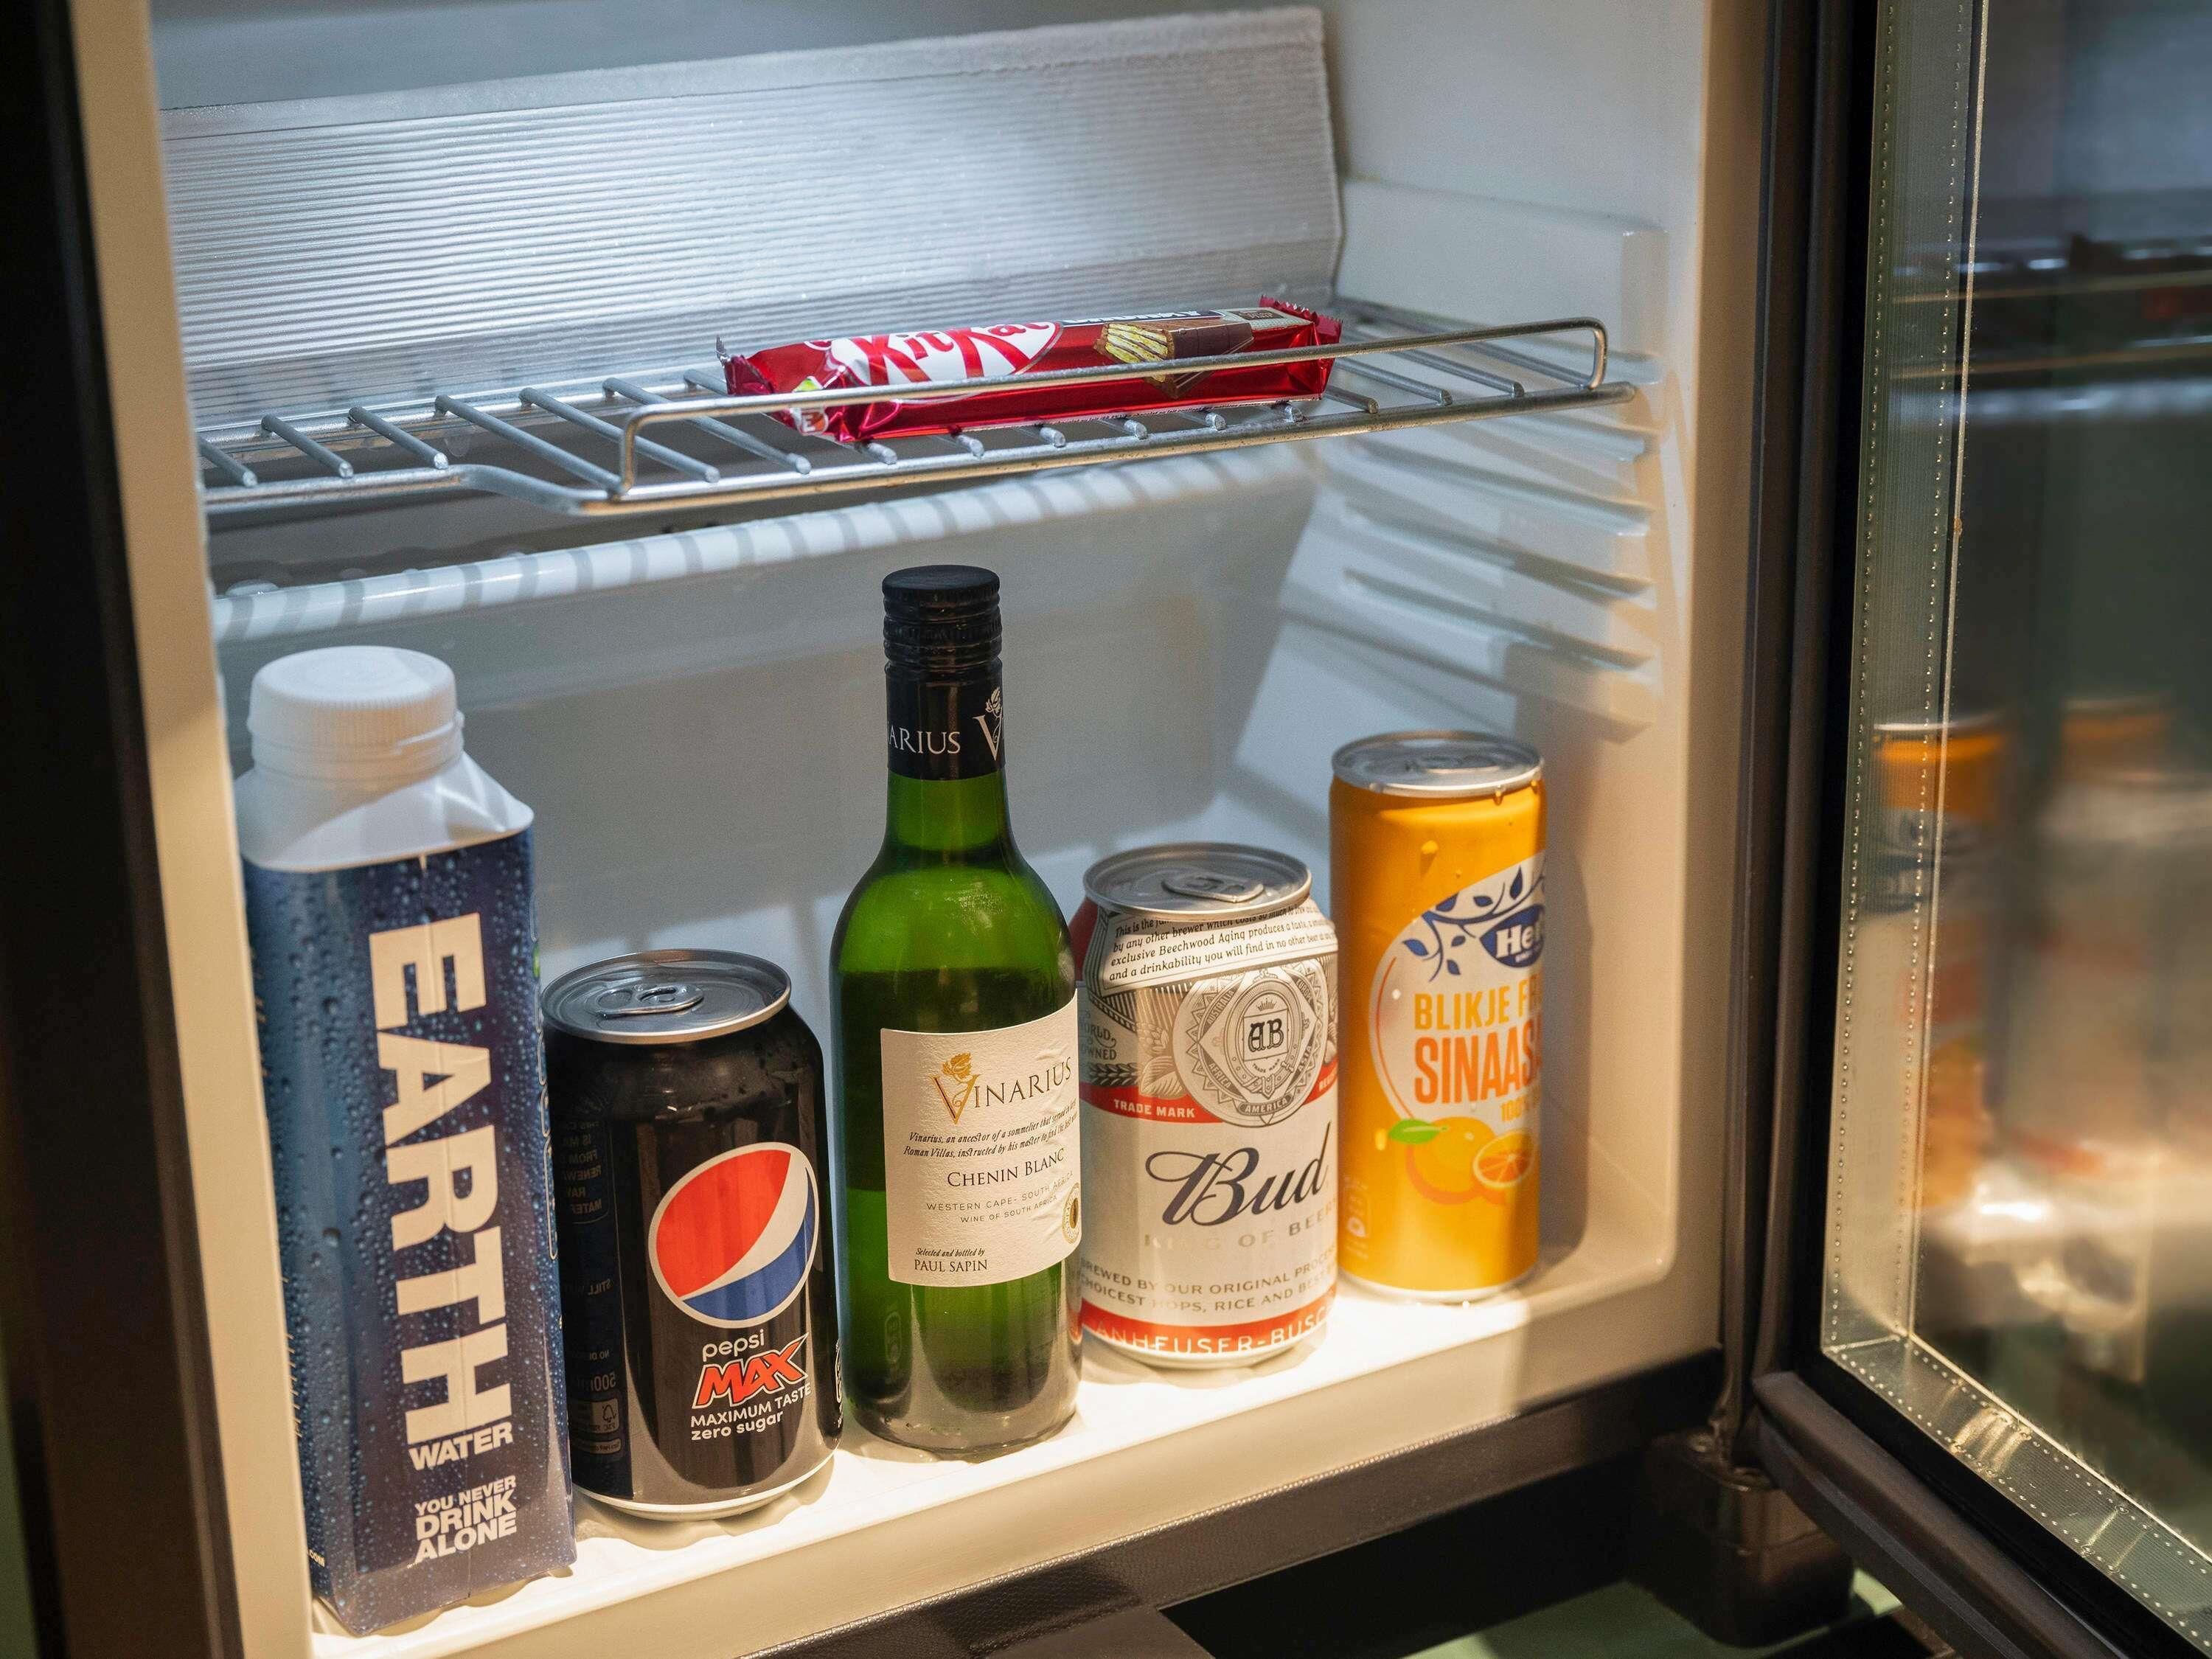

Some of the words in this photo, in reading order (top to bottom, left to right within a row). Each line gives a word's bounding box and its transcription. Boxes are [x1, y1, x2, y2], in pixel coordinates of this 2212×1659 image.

[1110, 949, 1155, 967] exclusive
[1159, 934, 1215, 956] Beechwood
[1218, 930, 1245, 944] Aging
[1248, 923, 1284, 939] produces
[1113, 941, 1124, 953] by
[1126, 937, 1144, 950] any
[1145, 931, 1169, 945] other
[1172, 923, 1204, 938] brewer
[1115, 923, 1132, 939] This
[1133, 922, 1140, 932] is
[1141, 917, 1154, 931] the
[1109, 967, 1128, 981] and
[1130, 968, 1137, 976] a
[1140, 955, 1202, 975] drinkability
[1204, 951, 1223, 964] you
[1225, 947, 1243, 958] will
[1245, 942, 1264, 956] find
[1266, 941, 1275, 950] in
[1276, 940, 1287, 949] no
[1287, 935, 1305, 947] other
[1206, 987, 1237, 1025] AUSTRALIA
[1414, 985, 1510, 1031] BLIKJE
[1248, 1018, 1285, 1053] AB
[1208, 1061, 1232, 1088] AFRICA
[1298, 1044, 1312, 1071] ASIA
[1113, 1099, 1152, 1116] TRADE
[1156, 1106, 1196, 1119] MARK
[1244, 1099, 1290, 1114] AMERICA
[903, 1145, 929, 1156] Roman
[931, 1147, 956, 1158] Villas,
[958, 1144, 997, 1158] instructed
[998, 1144, 1006, 1155] by
[1007, 1141, 1018, 1152] his
[1020, 1135, 1040, 1149] master
[1040, 1132, 1047, 1142] to
[908, 1131, 944, 1144] Vinarius,
[945, 1135, 956, 1143] an
[958, 1133, 991, 1143] ancestor
[992, 1129, 1001, 1142] of
[1007, 1121, 1040, 1137] sommelier
[1040, 1116, 1051, 1128] that
[369, 912, 512, 1445] EARTH
[947, 1165, 1019, 1187] CHENIN
[1025, 1147, 1065, 1177] BLANC
[1144, 1120, 1333, 1227] Bud
[926, 1202, 981, 1211] WESTERN
[1021, 1186, 1050, 1202] SOUTH
[1053, 1170, 1074, 1190] AFRICA
[960, 1215, 984, 1223] WINE
[989, 1212, 1000, 1221] OF
[1004, 1206, 1032, 1217] SOUTH
[1034, 1196, 1057, 1210] AFRICA
[915, 1247, 942, 1257] Selected
[941, 1248, 954, 1257] and
[954, 1248, 978, 1257] bottled
[978, 1248, 986, 1257] by
[1238, 1229, 1274, 1248] OF
[914, 1259, 945, 1272] PAUL
[949, 1259, 988, 1273] SAPIN
[1138, 1279, 1156, 1290] BY
[1164, 1282, 1203, 1295] OUR
[1209, 1272, 1291, 1295] ORIGINAL
[1214, 1297, 1256, 1311] RICE
[1261, 1288, 1294, 1305] AND
[702, 1329, 765, 1363] pepsi
[692, 1332, 810, 1409] MAX
[690, 1401, 772, 1427] MAXIMUM
[774, 1382, 812, 1409] TASTE
[691, 1425, 732, 1441] zero
[736, 1411, 784, 1433] sugar
[408, 1422, 514, 1470] WATER
[414, 1495, 454, 1516] YOU
[459, 1475, 517, 1506] NEVER
[415, 1489, 517, 1540] DRINK
[414, 1512, 517, 1563] ALONE
